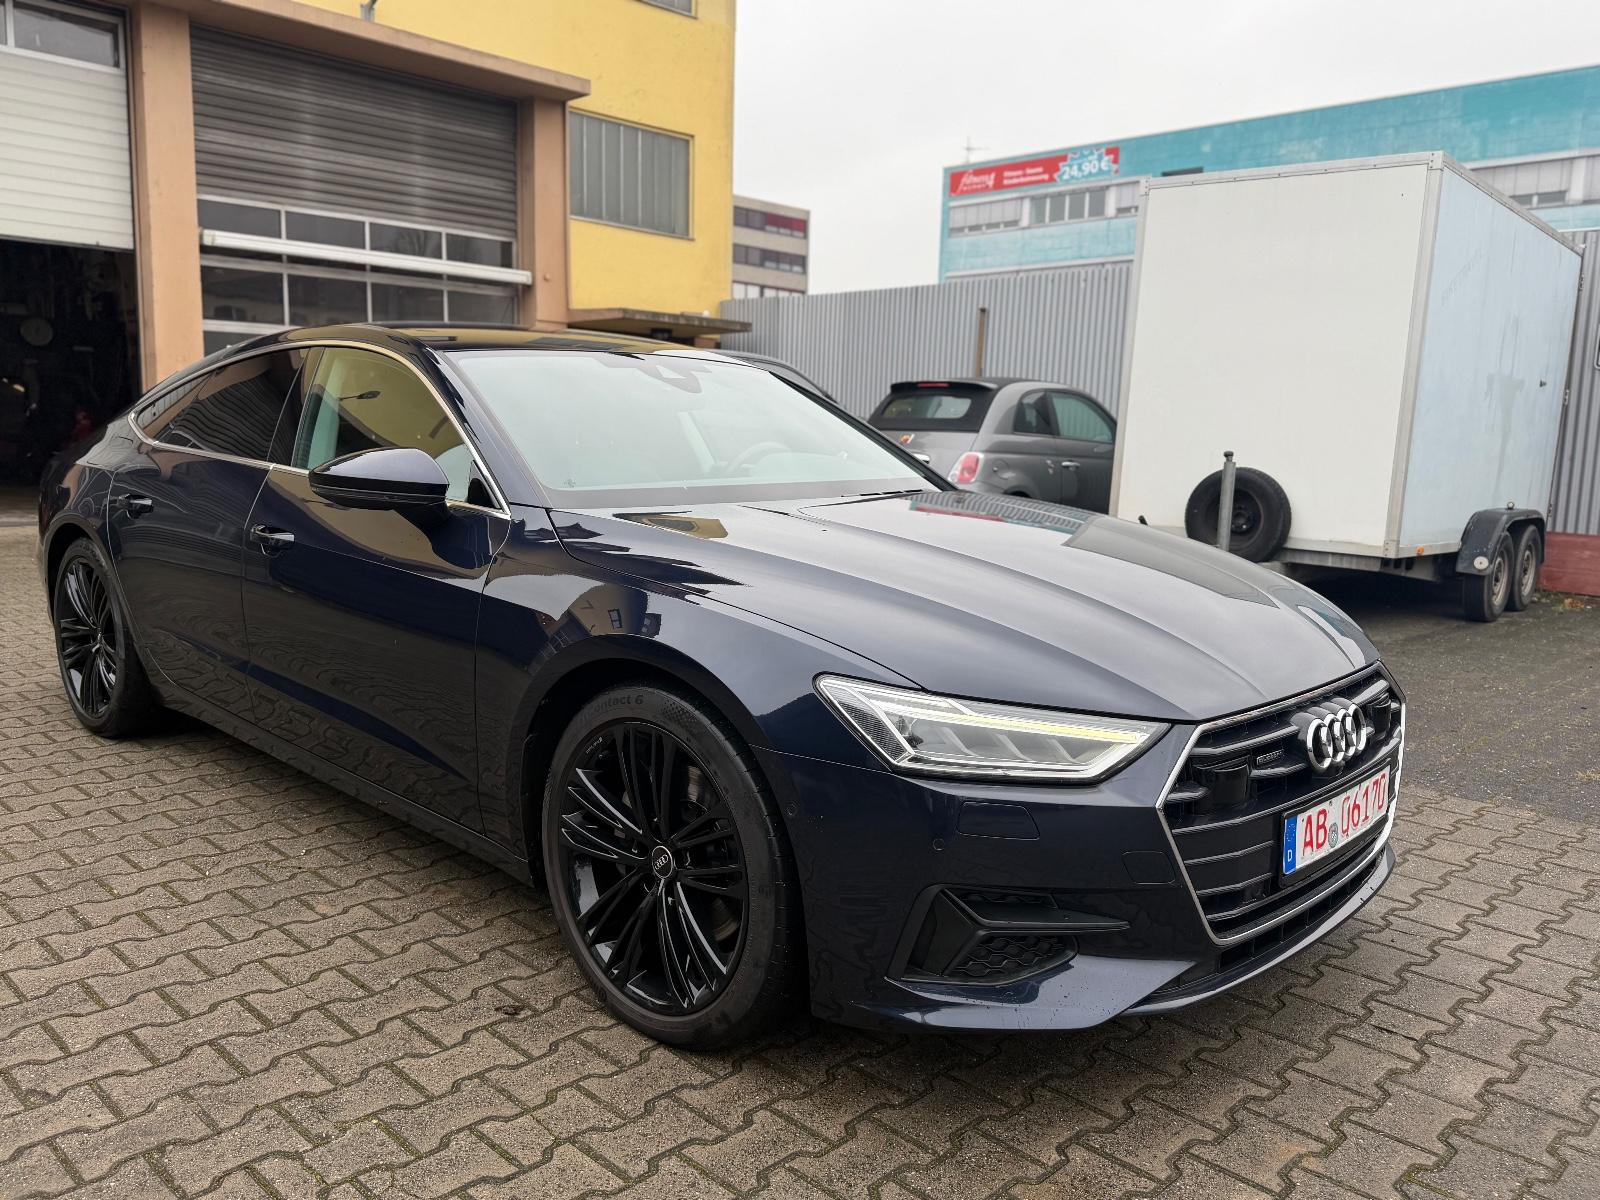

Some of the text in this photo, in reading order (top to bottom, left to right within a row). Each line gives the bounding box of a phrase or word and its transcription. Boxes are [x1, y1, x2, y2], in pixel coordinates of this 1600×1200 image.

[1062, 160, 1100, 181] 24,90
[635, 694, 644, 705] 6
[1302, 807, 1327, 855] AB
[1287, 848, 1293, 861] D
